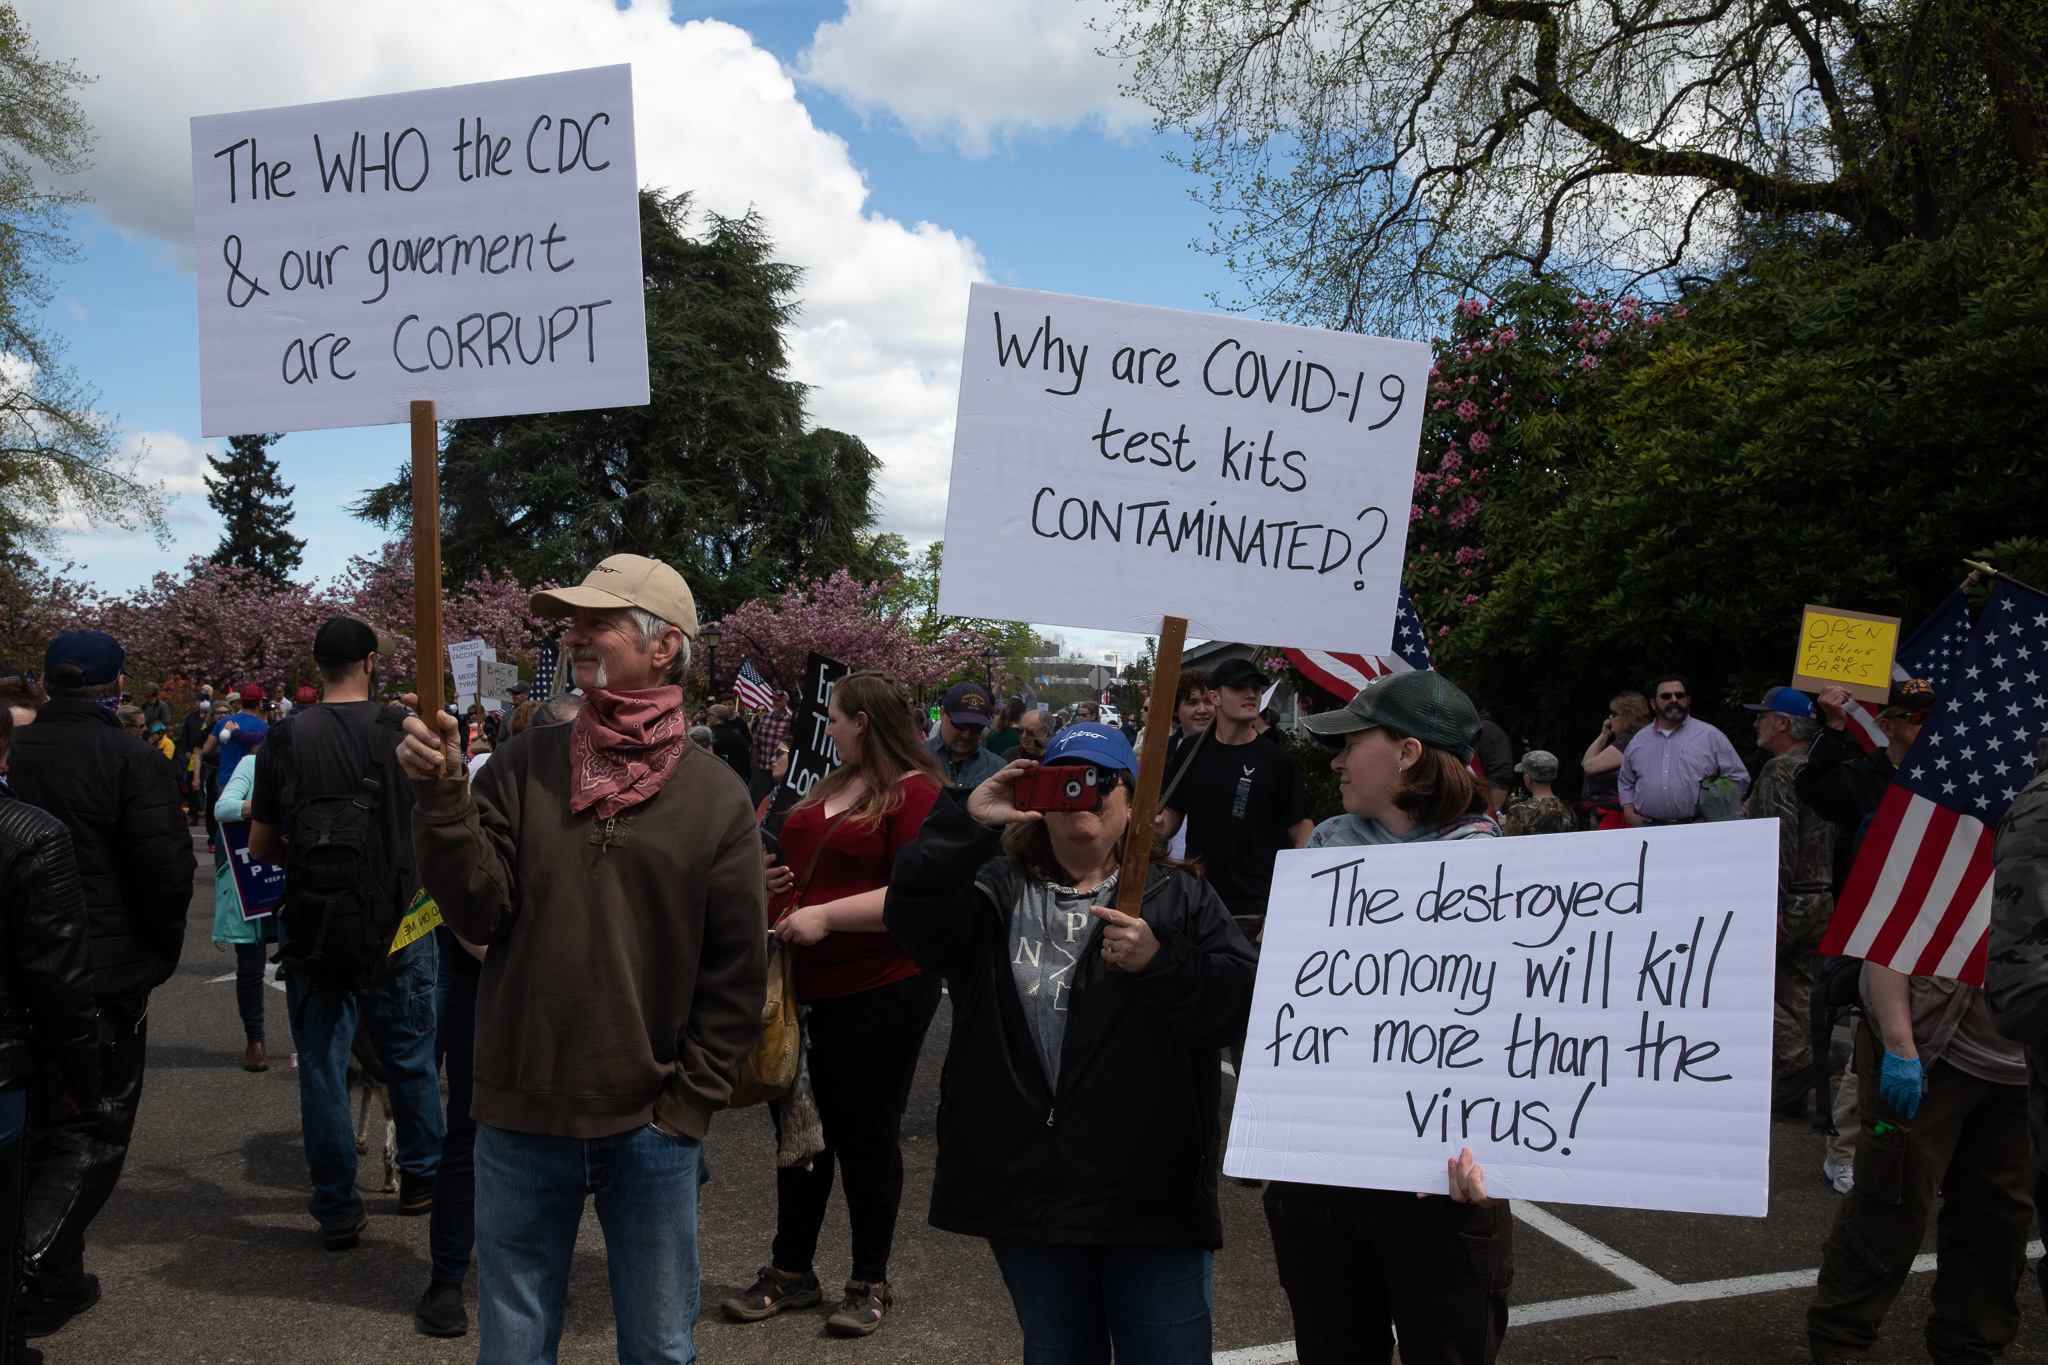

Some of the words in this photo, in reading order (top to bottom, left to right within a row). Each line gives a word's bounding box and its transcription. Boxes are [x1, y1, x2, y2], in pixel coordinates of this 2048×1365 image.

[214, 138, 295, 203] The
[314, 127, 429, 193] WHO
[453, 117, 512, 181] the
[526, 112, 610, 174] CDC
[223, 234, 270, 307] &
[280, 244, 348, 290] our
[362, 222, 575, 304] goverment
[282, 333, 357, 384] are
[393, 299, 612, 373] CORRUPT
[994, 311, 1088, 395] Why
[1111, 347, 1180, 387] are
[1091, 408, 1197, 472] test
[1221, 426, 1307, 492] kits
[1809, 619, 1882, 639] OPEN
[451, 650, 483, 660] VACCINES
[452, 643, 479, 652] FORCED
[1808, 640, 1876, 655] FISHING
[458, 672, 478, 680] MEDIC
[487, 664, 513, 677] BACK
[496, 678, 507, 686] TO
[1806, 655, 1874, 677] PARKS
[1310, 858, 1403, 927] The
[1416, 840, 1648, 948] destroyed
[1065, 912, 1088, 943] P
[1012, 936, 1043, 968] N
[1295, 948, 1496, 1016] economy
[1526, 930, 1613, 1009] will
[1637, 910, 1733, 1008] kill
[1265, 1002, 1348, 1067] far
[1372, 1017, 1484, 1068] more
[1504, 1012, 1607, 1087] than
[1625, 1010, 1732, 1082] the
[1405, 1081, 1596, 1156] virus!
